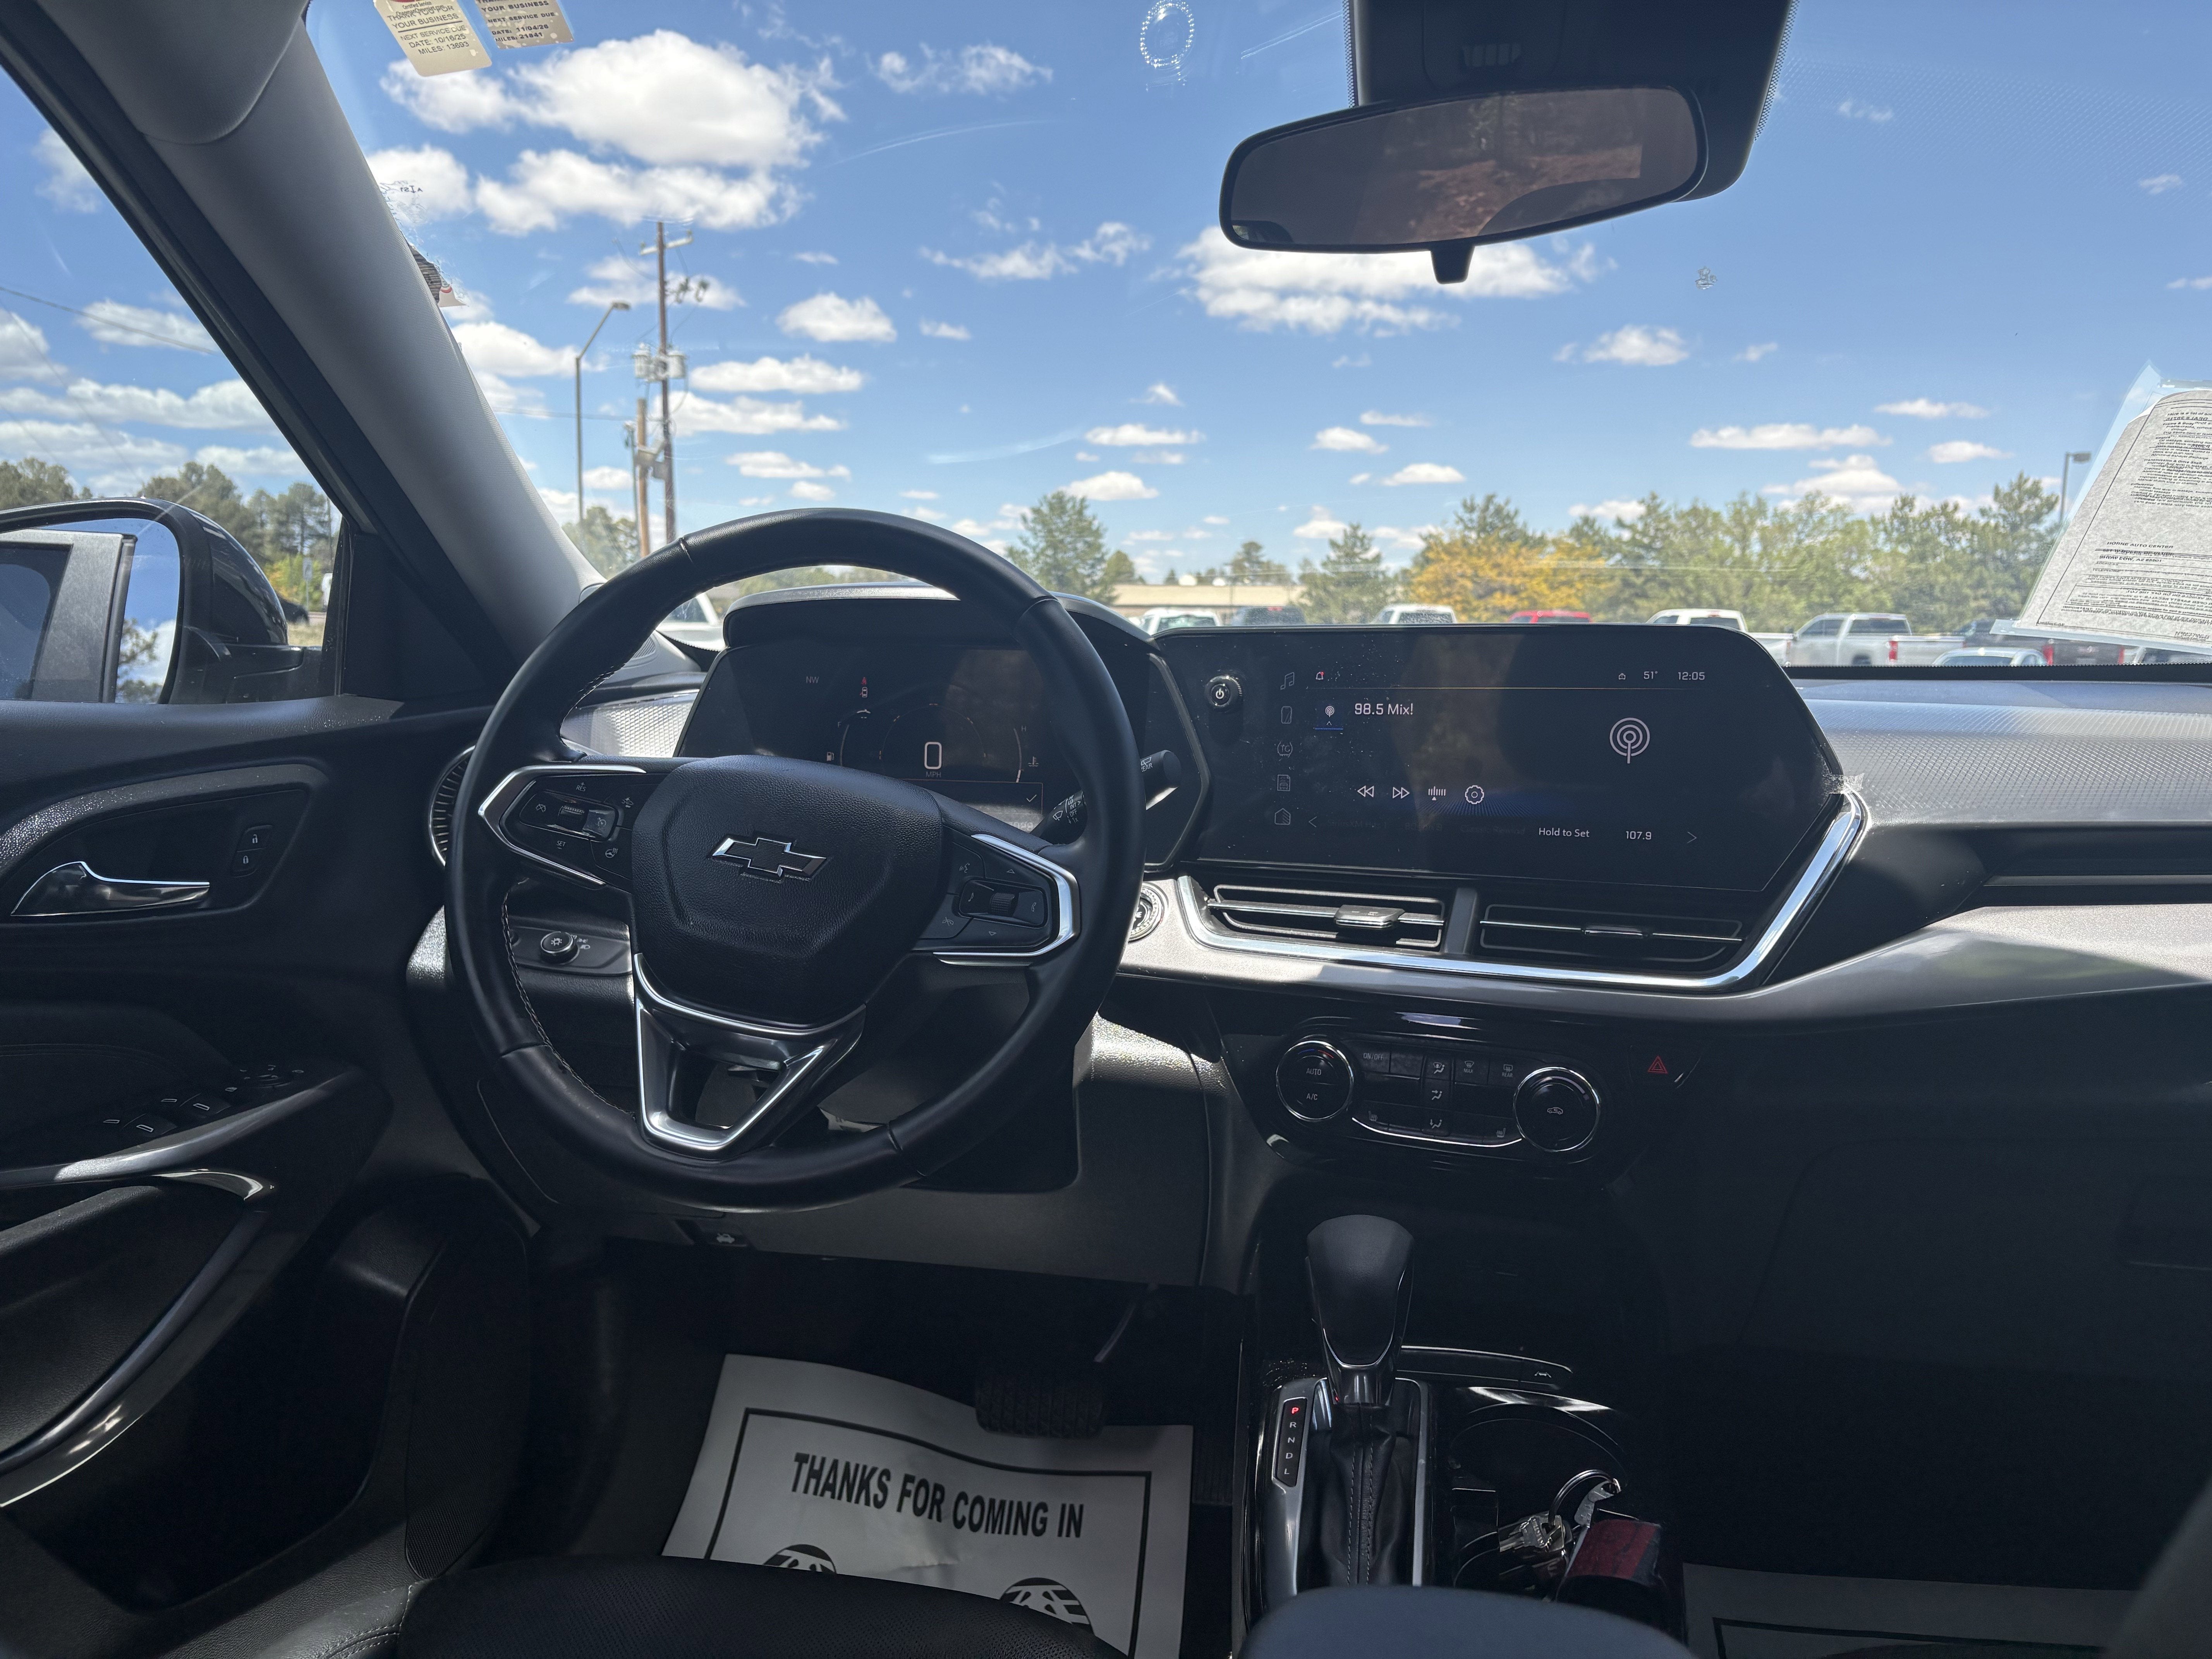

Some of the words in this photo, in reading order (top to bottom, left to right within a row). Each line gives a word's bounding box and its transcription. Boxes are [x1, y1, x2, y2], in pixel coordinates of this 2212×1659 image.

[508, 0, 549, 9] BUSINESS
[392, 20, 417, 29] YOUR
[419, 13, 459, 25] BUSINESS
[420, 28, 450, 38] SERVICE
[418, 46, 445, 55] MILES:
[1678, 672, 1705, 681] 12:05
[1355, 703, 1383, 715] 98.5
[1387, 703, 1413, 715] Mix!
[924, 742, 942, 769] 0
[1539, 828, 1560, 837] Hold
[1575, 829, 1590, 838] Set
[1626, 831, 1652, 840] 107.9
[1363, 1053, 1384, 1061] ON/OFF
[792, 1452, 890, 1509] THANKS
[896, 1474, 945, 1522] FOR
[952, 1491, 1048, 1537] COMING
[1057, 1503, 1084, 1538] IN
